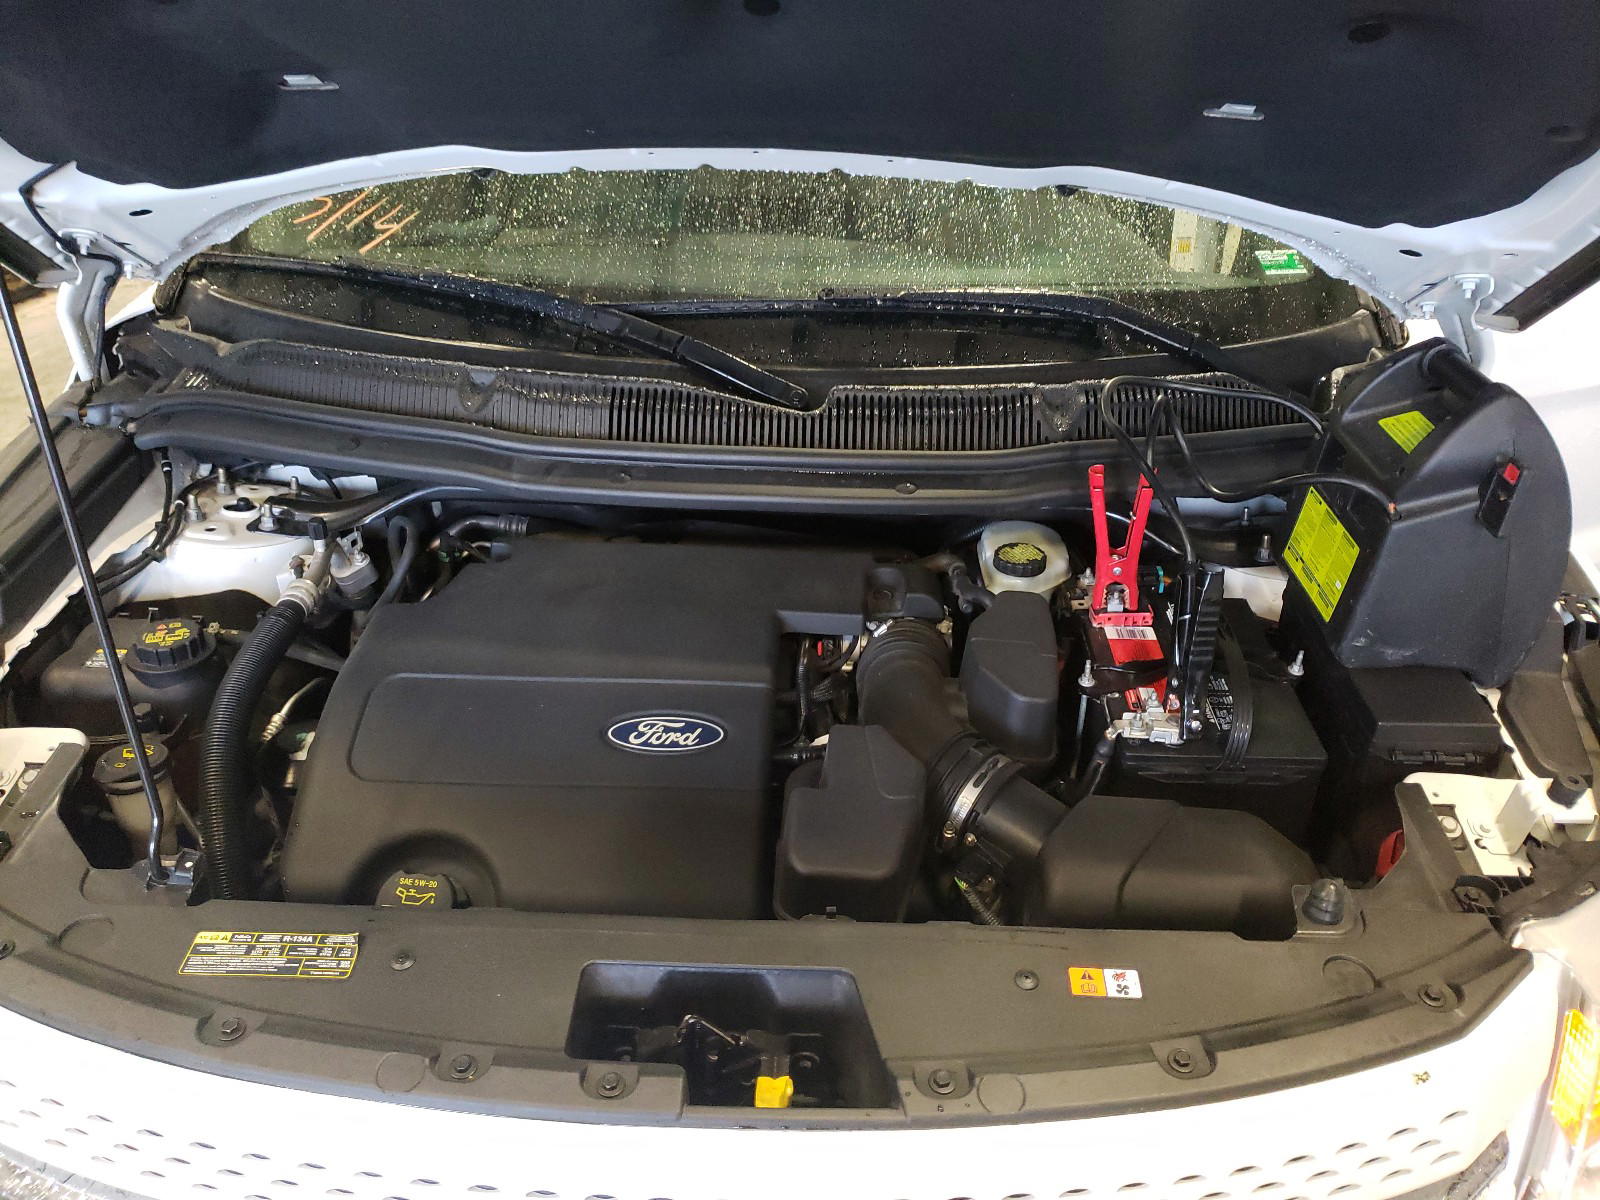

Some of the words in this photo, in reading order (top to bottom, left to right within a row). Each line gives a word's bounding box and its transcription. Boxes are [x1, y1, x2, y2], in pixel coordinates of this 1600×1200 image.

[628, 720, 703, 746] Ford
[400, 877, 413, 886] SAE
[414, 879, 438, 888] 5W-20
[282, 935, 313, 943] R-134A
